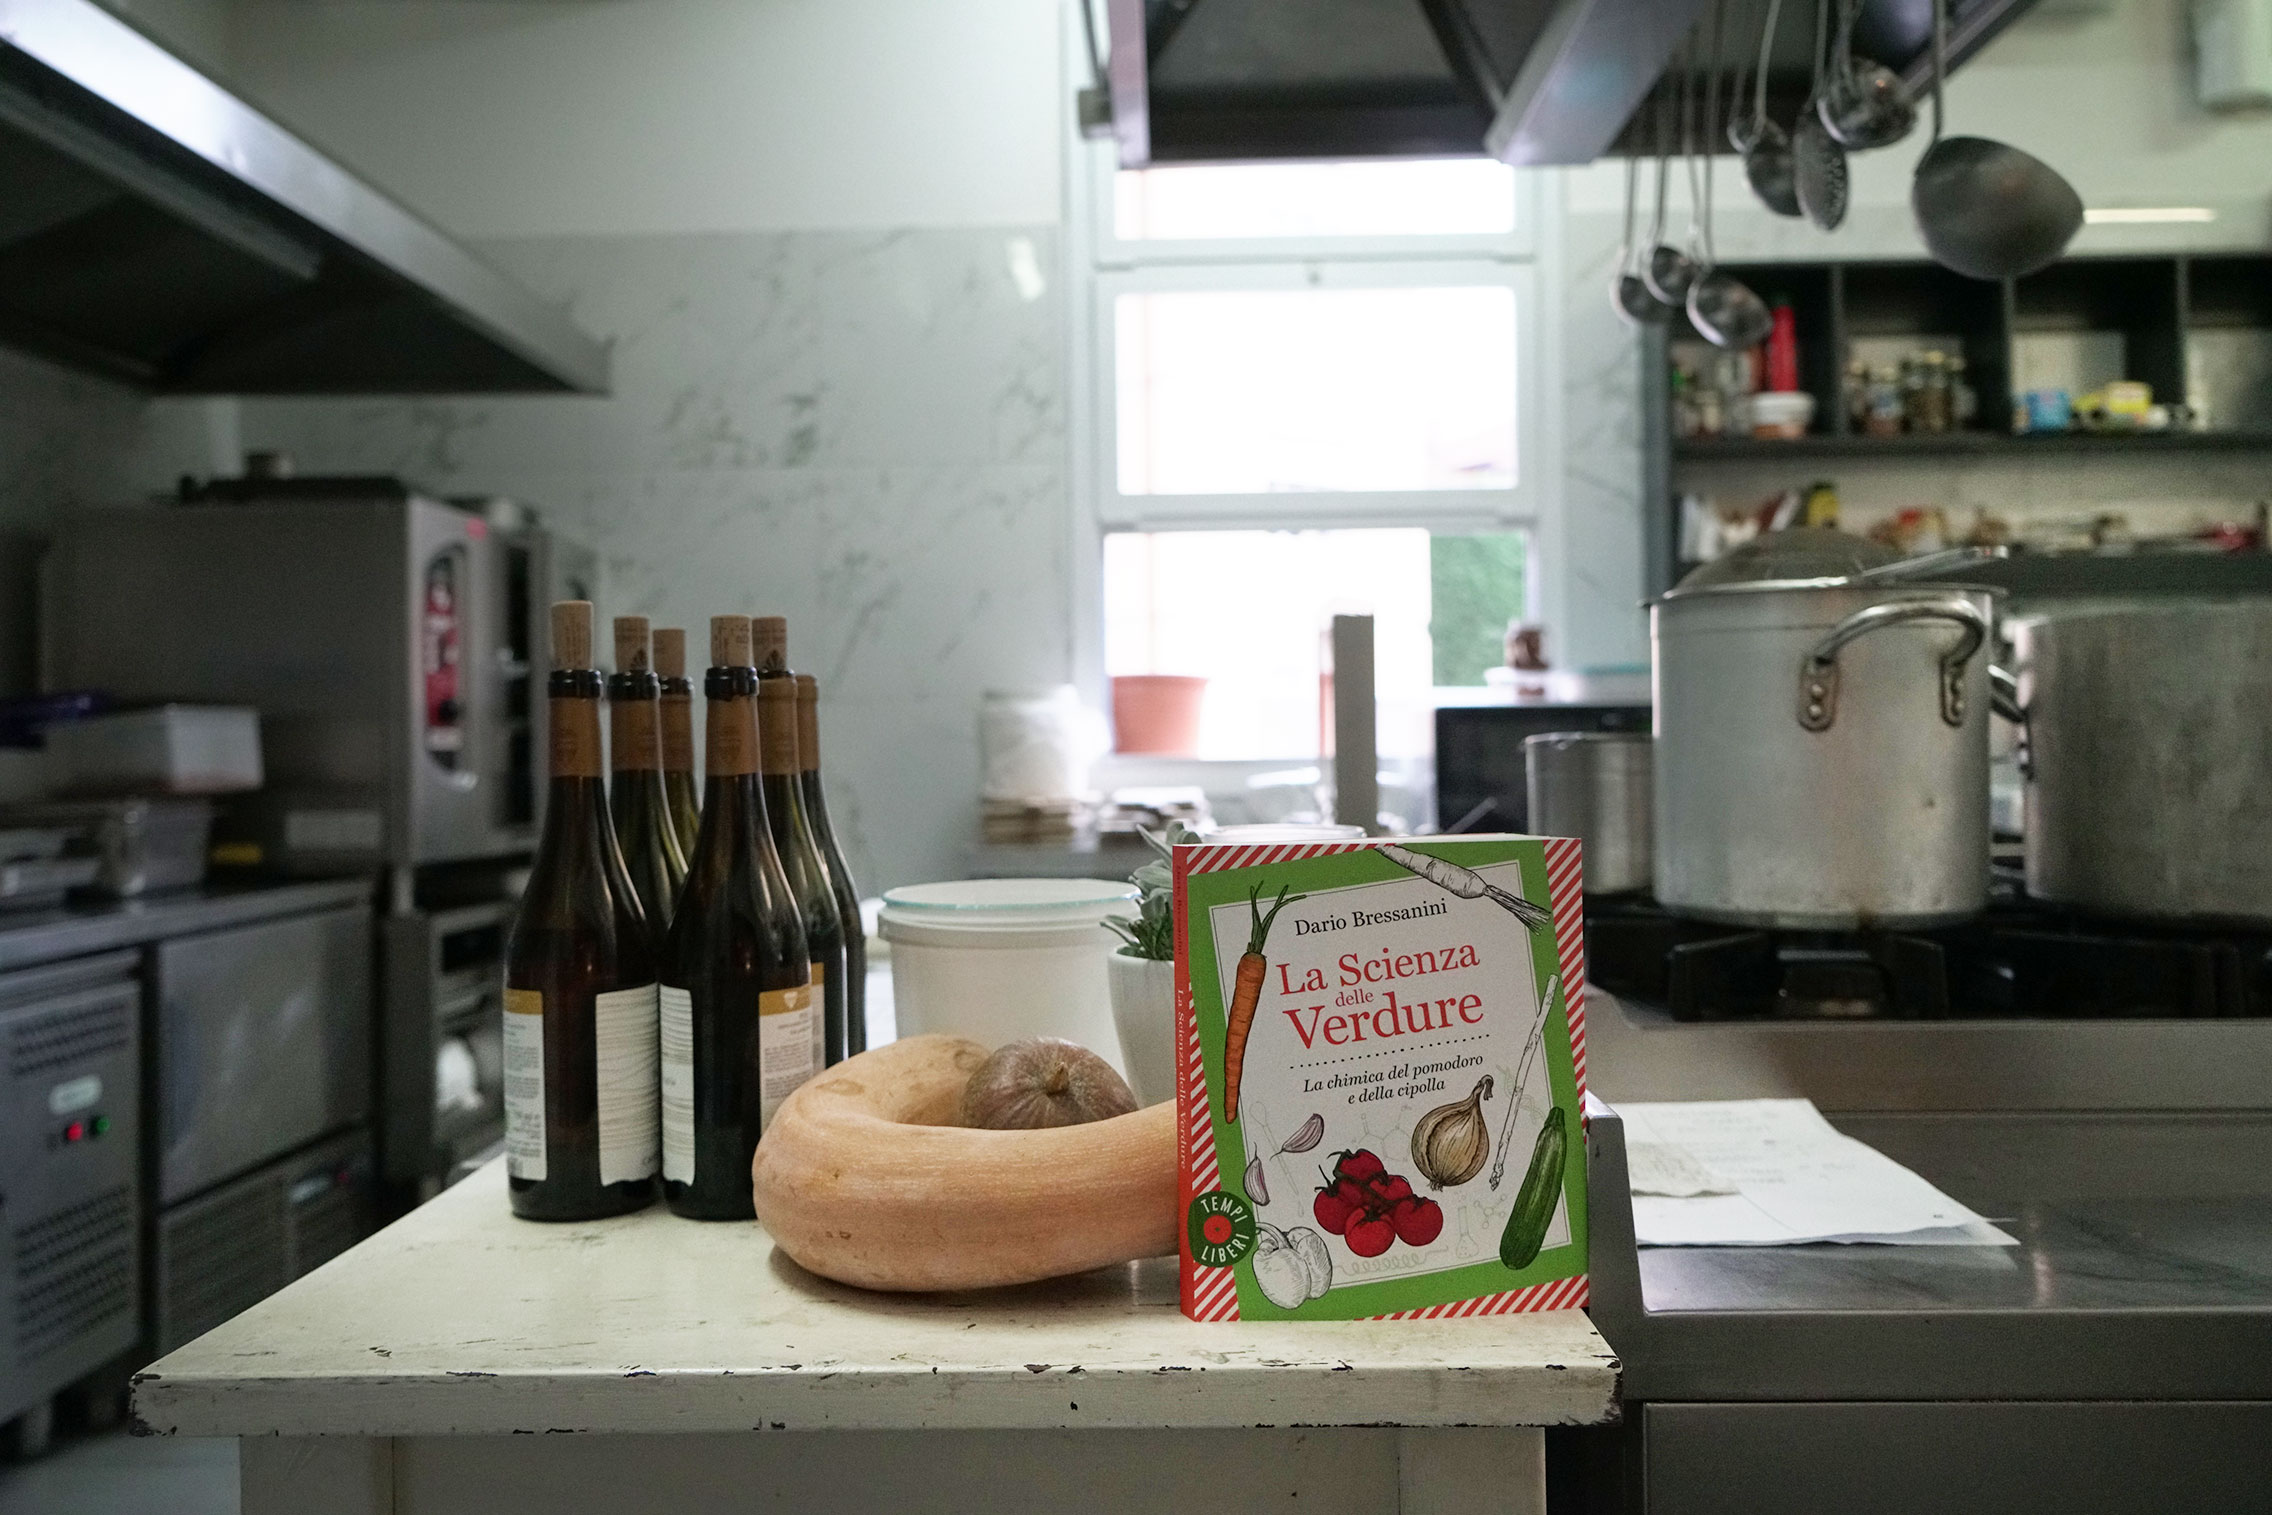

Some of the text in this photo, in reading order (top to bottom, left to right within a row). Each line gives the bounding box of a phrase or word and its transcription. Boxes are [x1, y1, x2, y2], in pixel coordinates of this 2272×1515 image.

[1295, 898, 1448, 936] Dario Bressanini
[1276, 944, 1480, 995] La Scienza
[1335, 989, 1374, 1007] delle
[1177, 1010, 1185, 1067] Scienza
[1282, 991, 1484, 1049] Verdure
[1178, 1070, 1187, 1107] delle
[1303, 1055, 1483, 1093] La chimica del pomodoro
[1348, 1077, 1446, 1105] e della cipolla
[1179, 1110, 1187, 1169] Verdure
[1200, 1196, 1248, 1223] TEMPI
[1201, 1233, 1250, 1263] LIBERI
